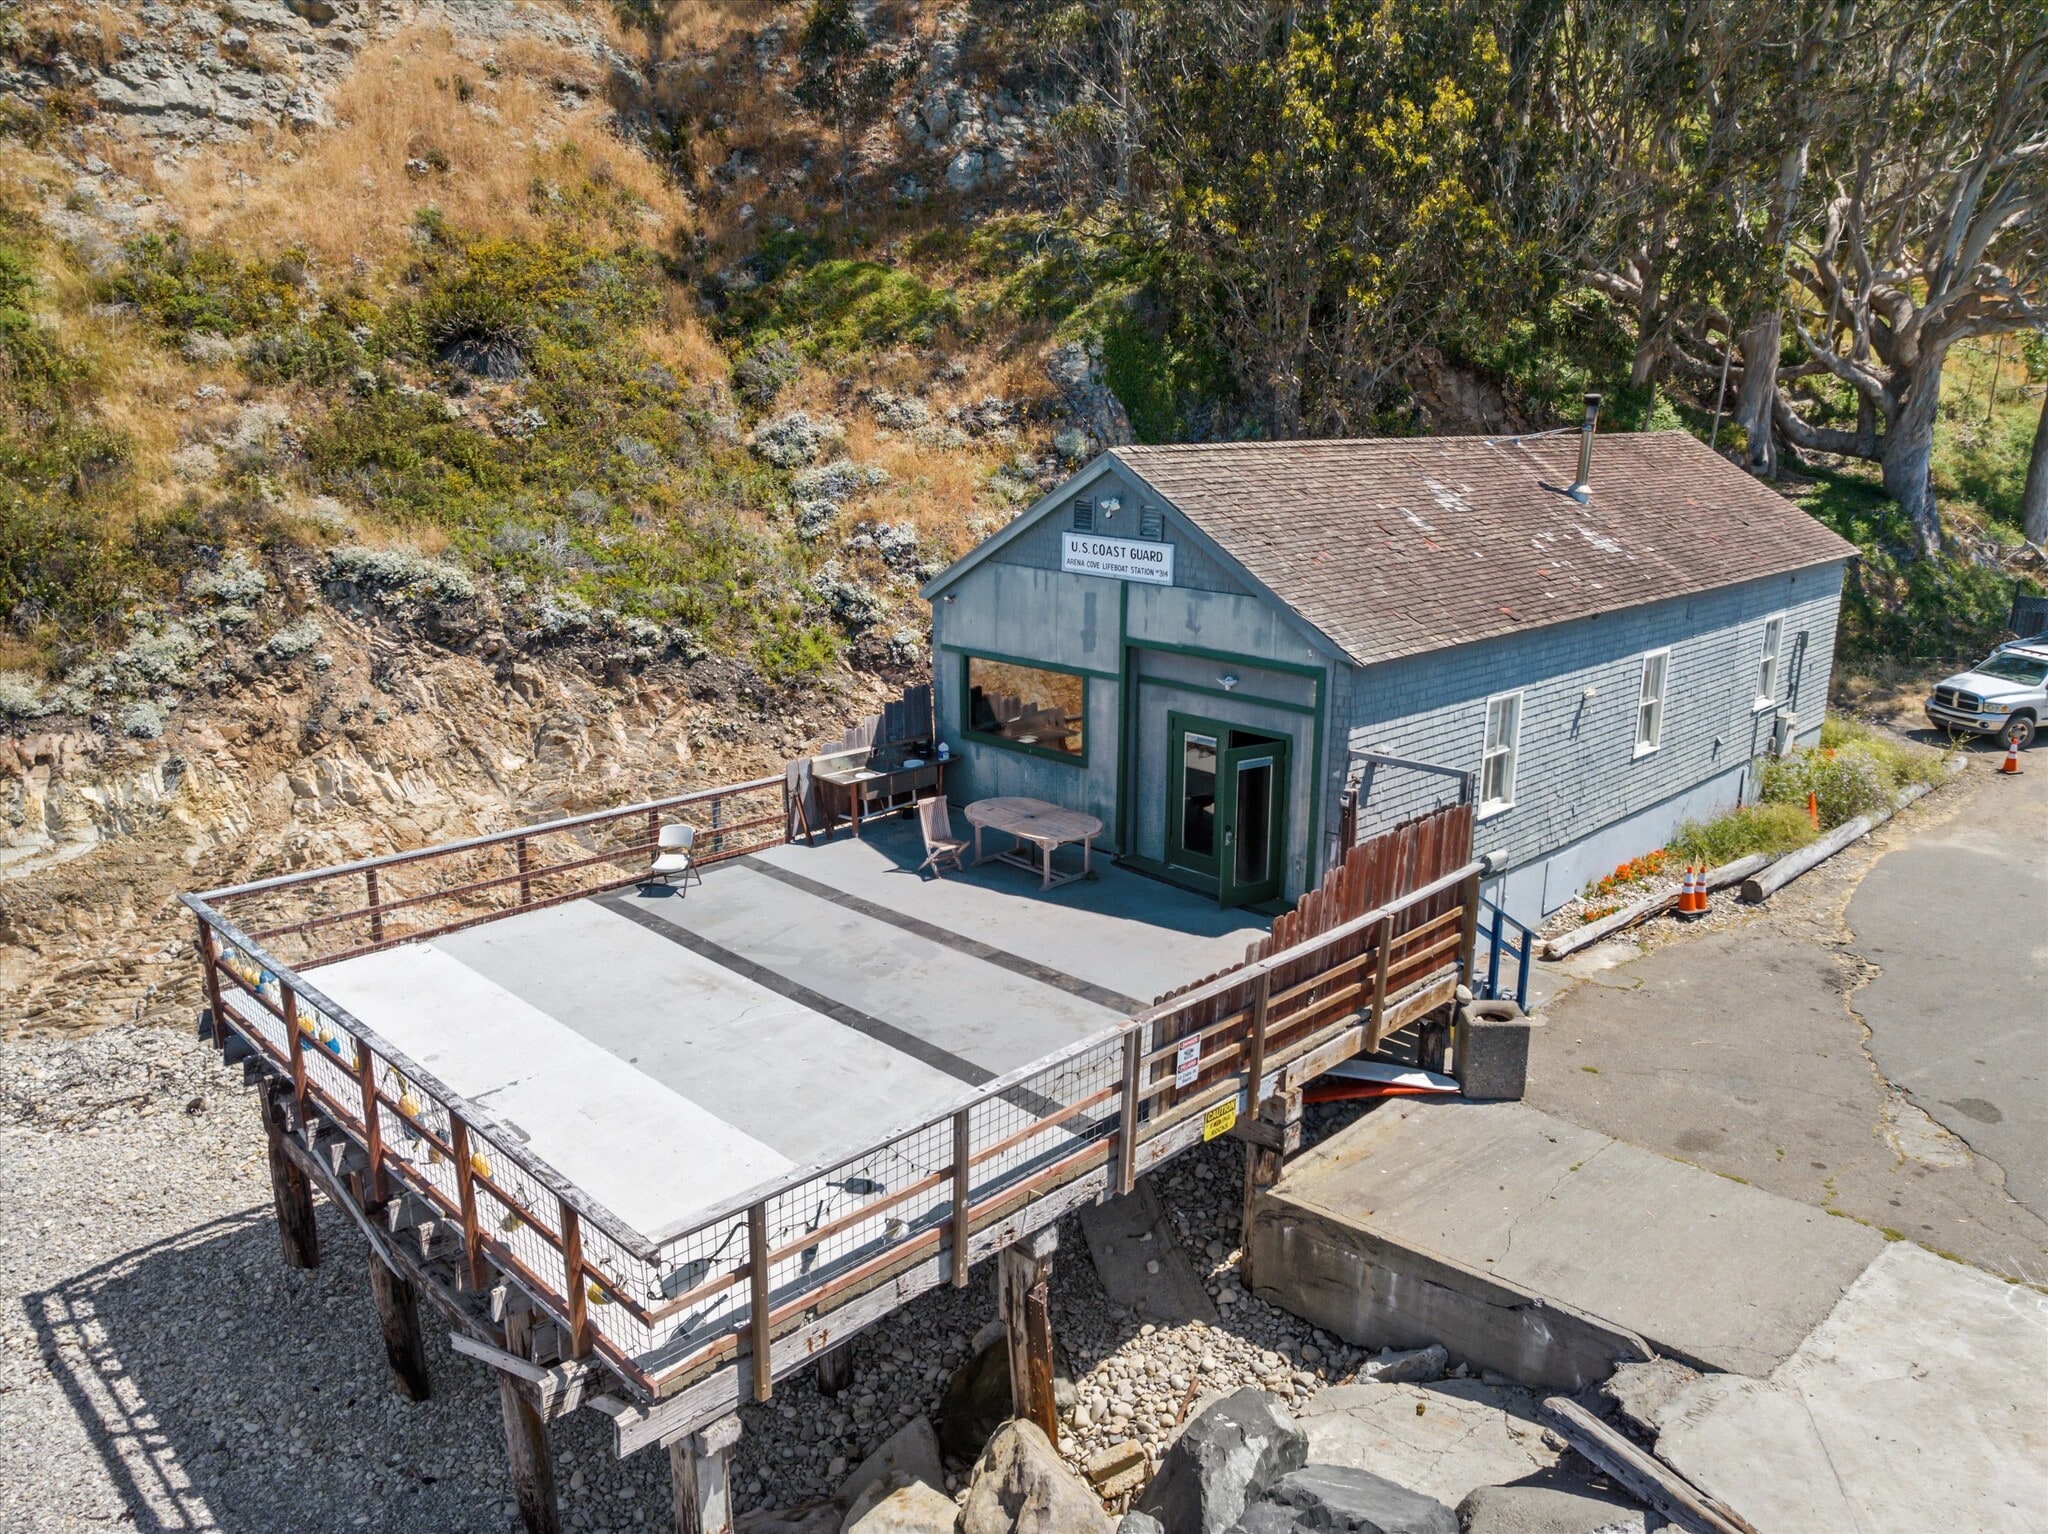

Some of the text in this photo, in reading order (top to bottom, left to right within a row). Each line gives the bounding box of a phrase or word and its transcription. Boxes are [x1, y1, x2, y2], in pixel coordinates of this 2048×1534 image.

[1092, 543, 1126, 558] COAST
[1130, 548, 1163, 562] GUARD
[1066, 558, 1085, 567] ARENA
[1086, 560, 1101, 569] COVE
[1102, 562, 1128, 573] LIFEBOAT
[1130, 566, 1155, 576] STATION
[1207, 1101, 1236, 1121] CAUTION
